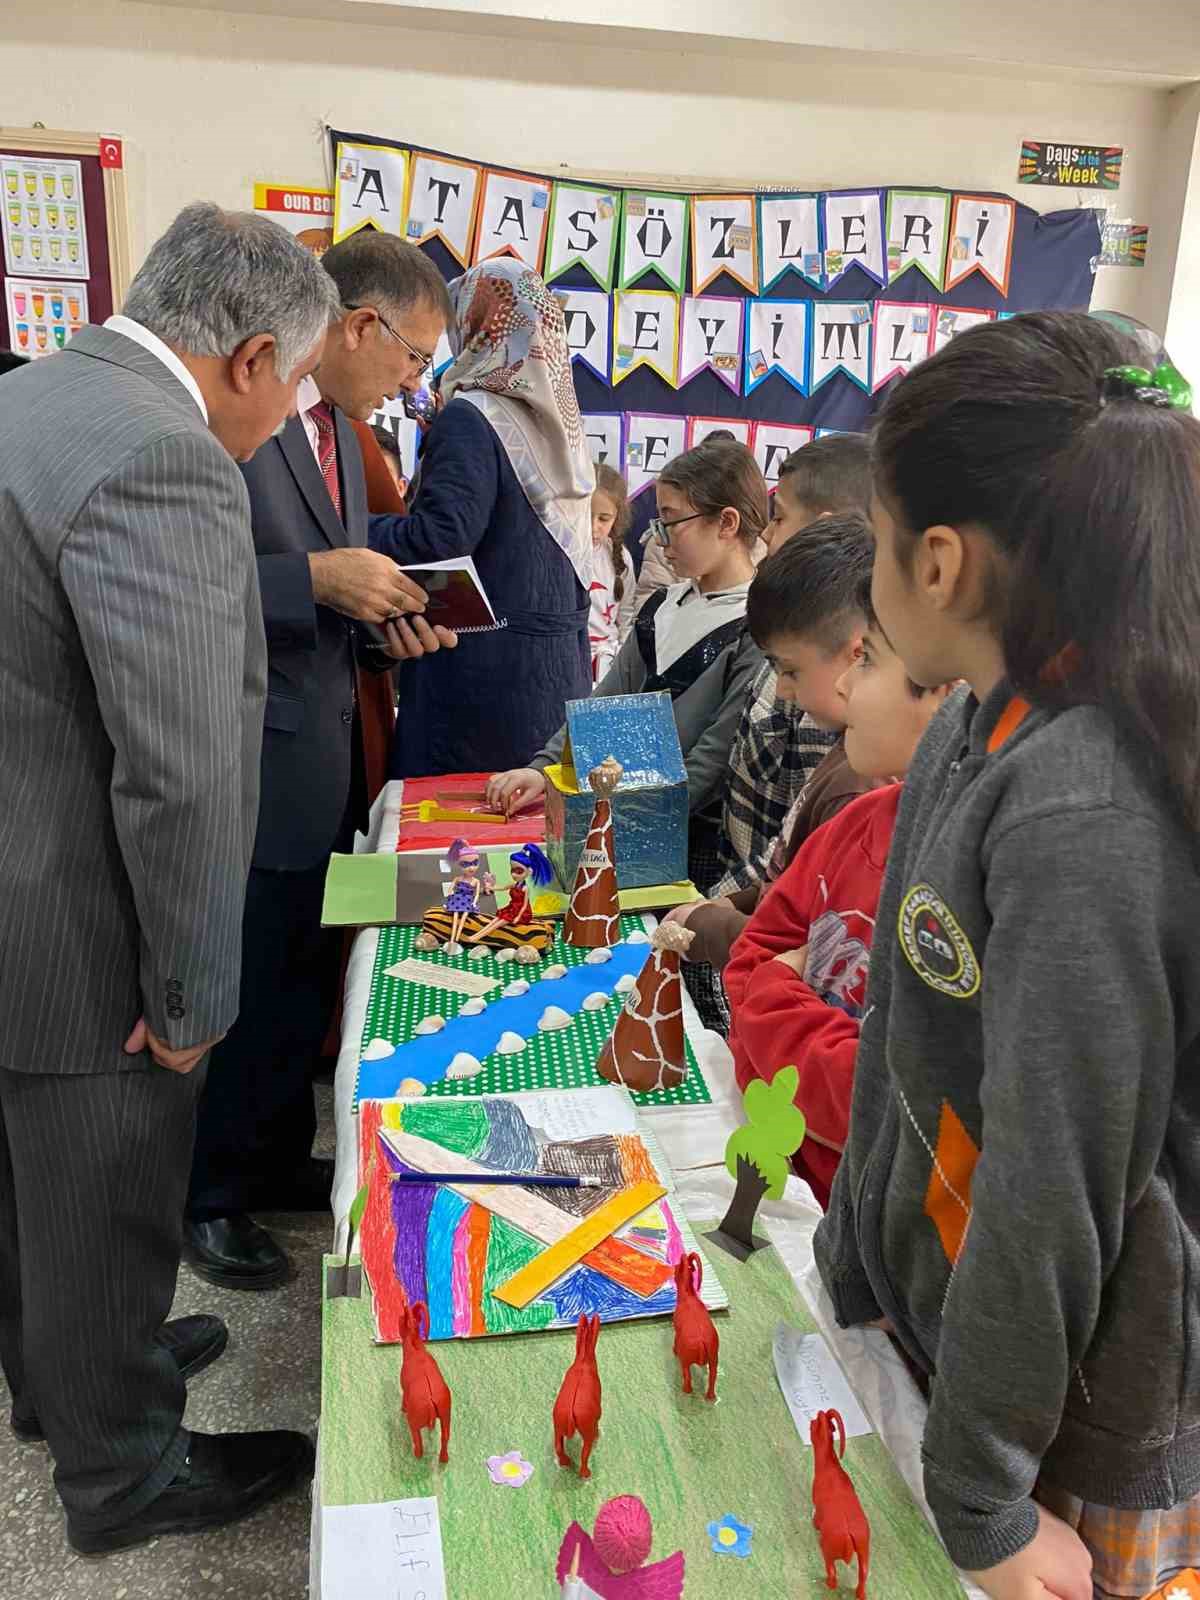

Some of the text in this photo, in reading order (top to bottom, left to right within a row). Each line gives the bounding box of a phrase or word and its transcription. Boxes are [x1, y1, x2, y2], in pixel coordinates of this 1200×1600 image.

[1046, 145, 1080, 166] Days
[1057, 166, 1099, 184] Week
[283, 193, 310, 210] OUR
